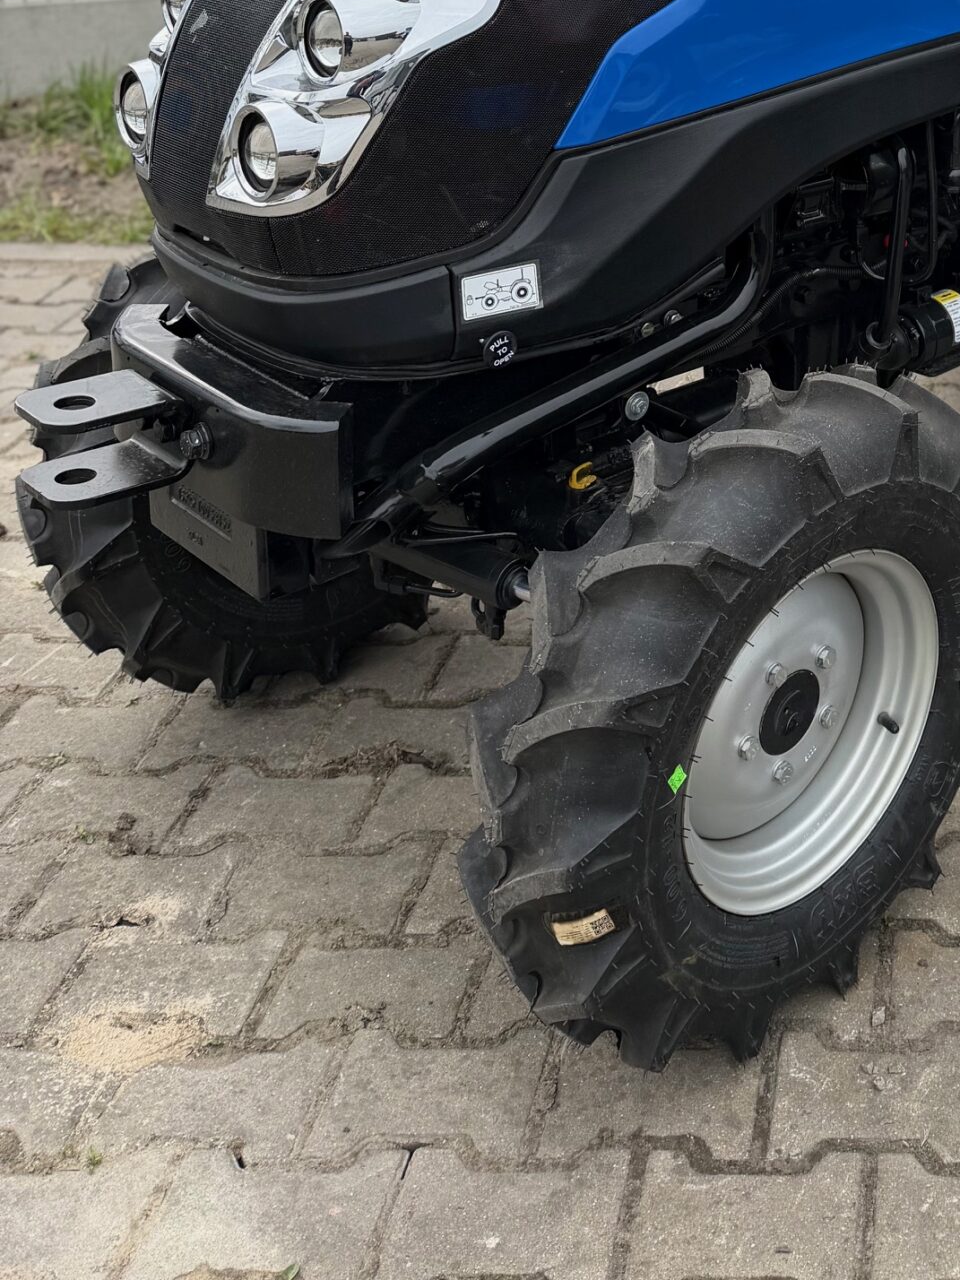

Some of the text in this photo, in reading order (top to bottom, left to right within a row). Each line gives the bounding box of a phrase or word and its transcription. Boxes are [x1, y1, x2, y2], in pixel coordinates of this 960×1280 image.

[489, 336, 509, 352] PULL
[497, 346, 508, 356] TO
[493, 350, 515, 367] OPEN
